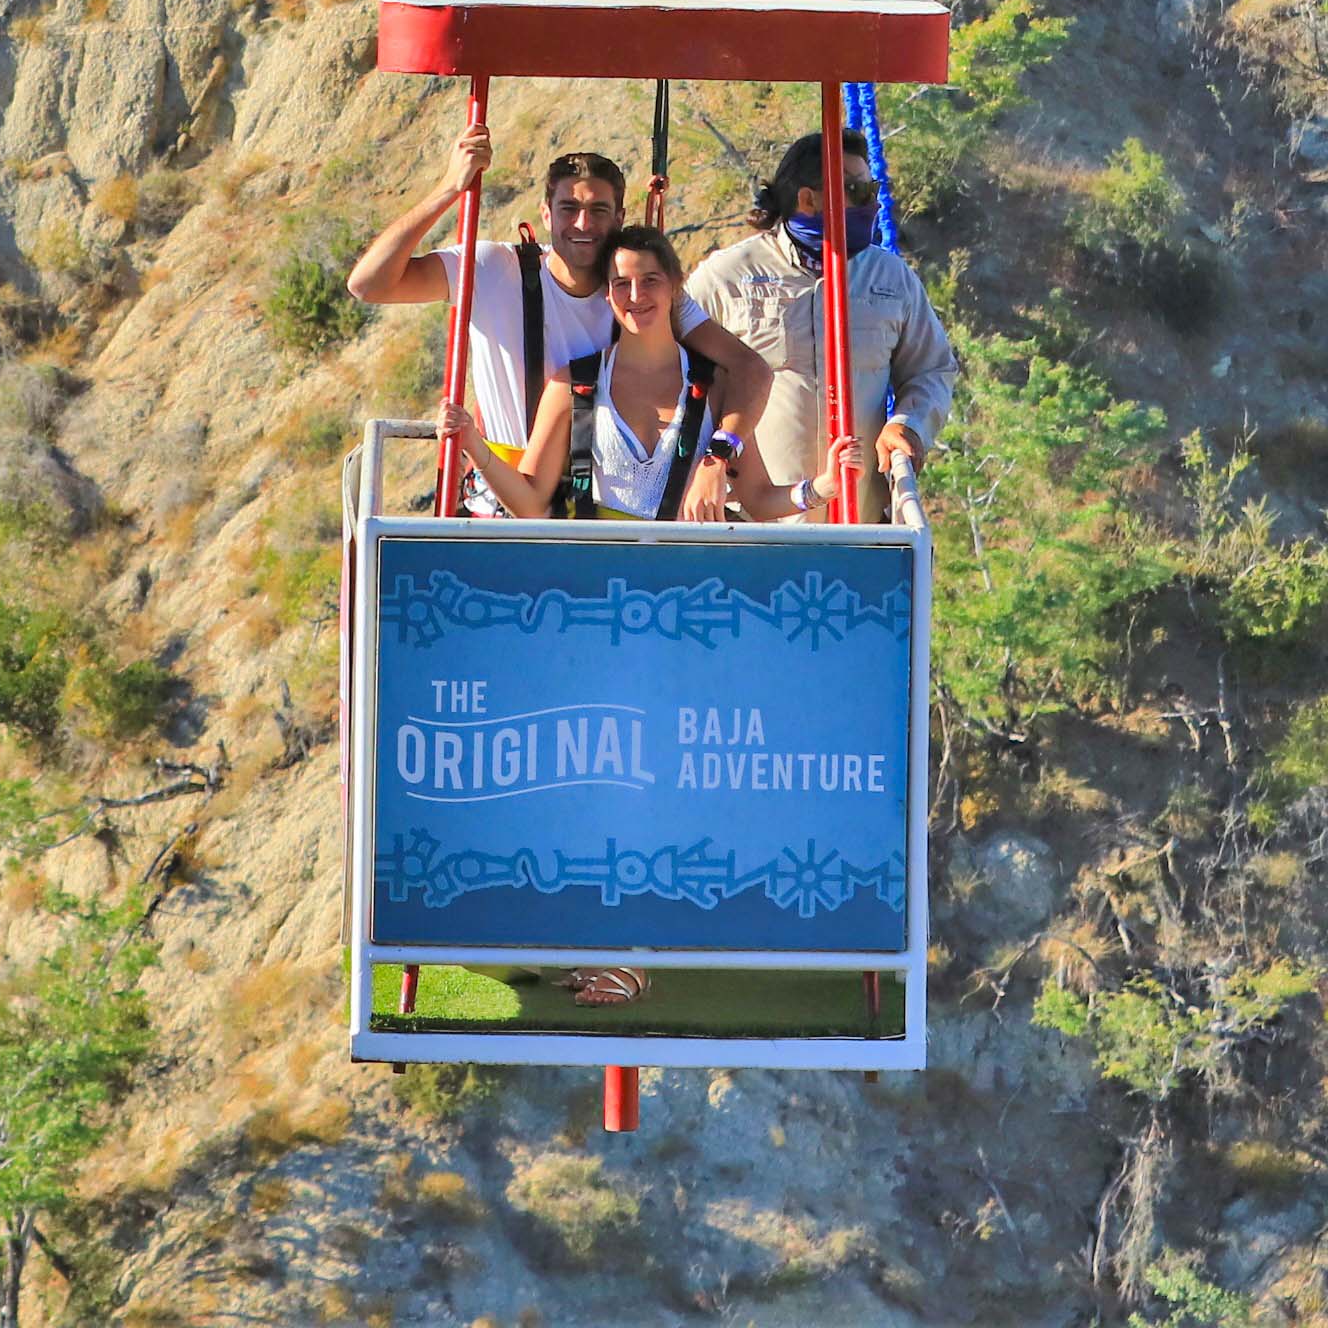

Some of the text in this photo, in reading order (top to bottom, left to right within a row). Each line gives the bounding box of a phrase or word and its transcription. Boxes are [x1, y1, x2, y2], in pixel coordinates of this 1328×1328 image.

[431, 680, 488, 714] THE
[678, 707, 766, 746] BAJA
[396, 716, 655, 790] ORIGINAL
[677, 753, 886, 793] ADVENTURE
